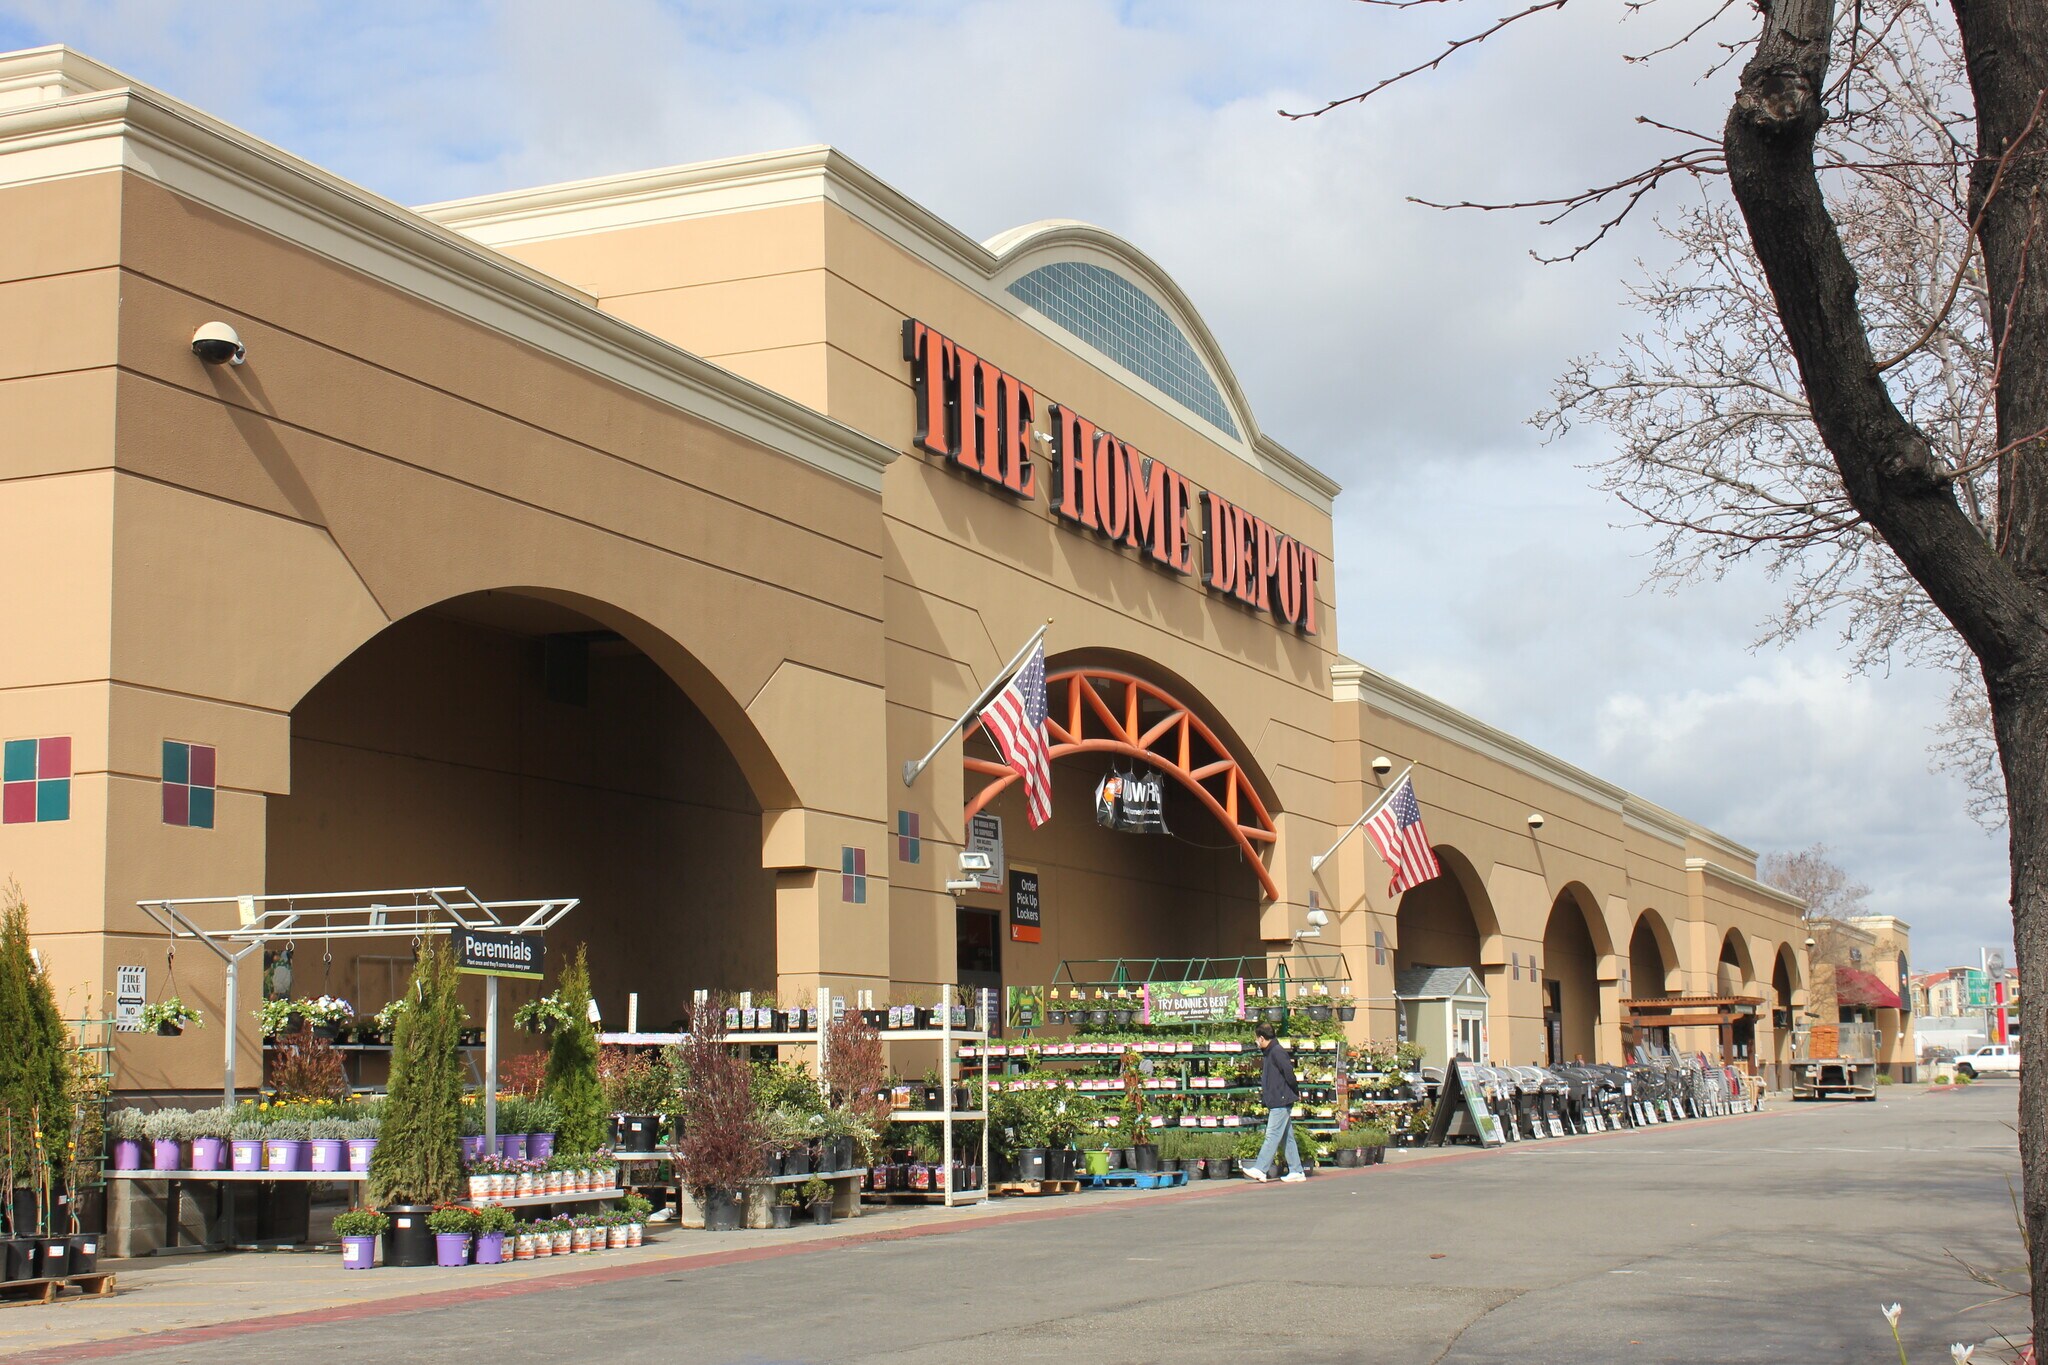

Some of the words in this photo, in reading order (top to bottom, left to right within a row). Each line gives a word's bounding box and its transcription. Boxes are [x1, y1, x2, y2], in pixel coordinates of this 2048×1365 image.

[904, 318, 1035, 500] THE
[1048, 403, 1193, 577] HOME
[1199, 490, 1319, 636] DEPOT
[1021, 879, 1037, 892] Order
[1016, 892, 1029, 906] Pick
[1029, 894, 1038, 909] Up
[1016, 907, 1039, 921] Lockers
[465, 936, 532, 961] Perennials
[122, 974, 141, 984] FIRE
[121, 984, 141, 994] LANE
[1158, 998, 1173, 1010] TRY
[1174, 996, 1208, 1010] BONNIE'S
[1209, 995, 1229, 1008] BEST
[125, 1007, 136, 1015] NO
